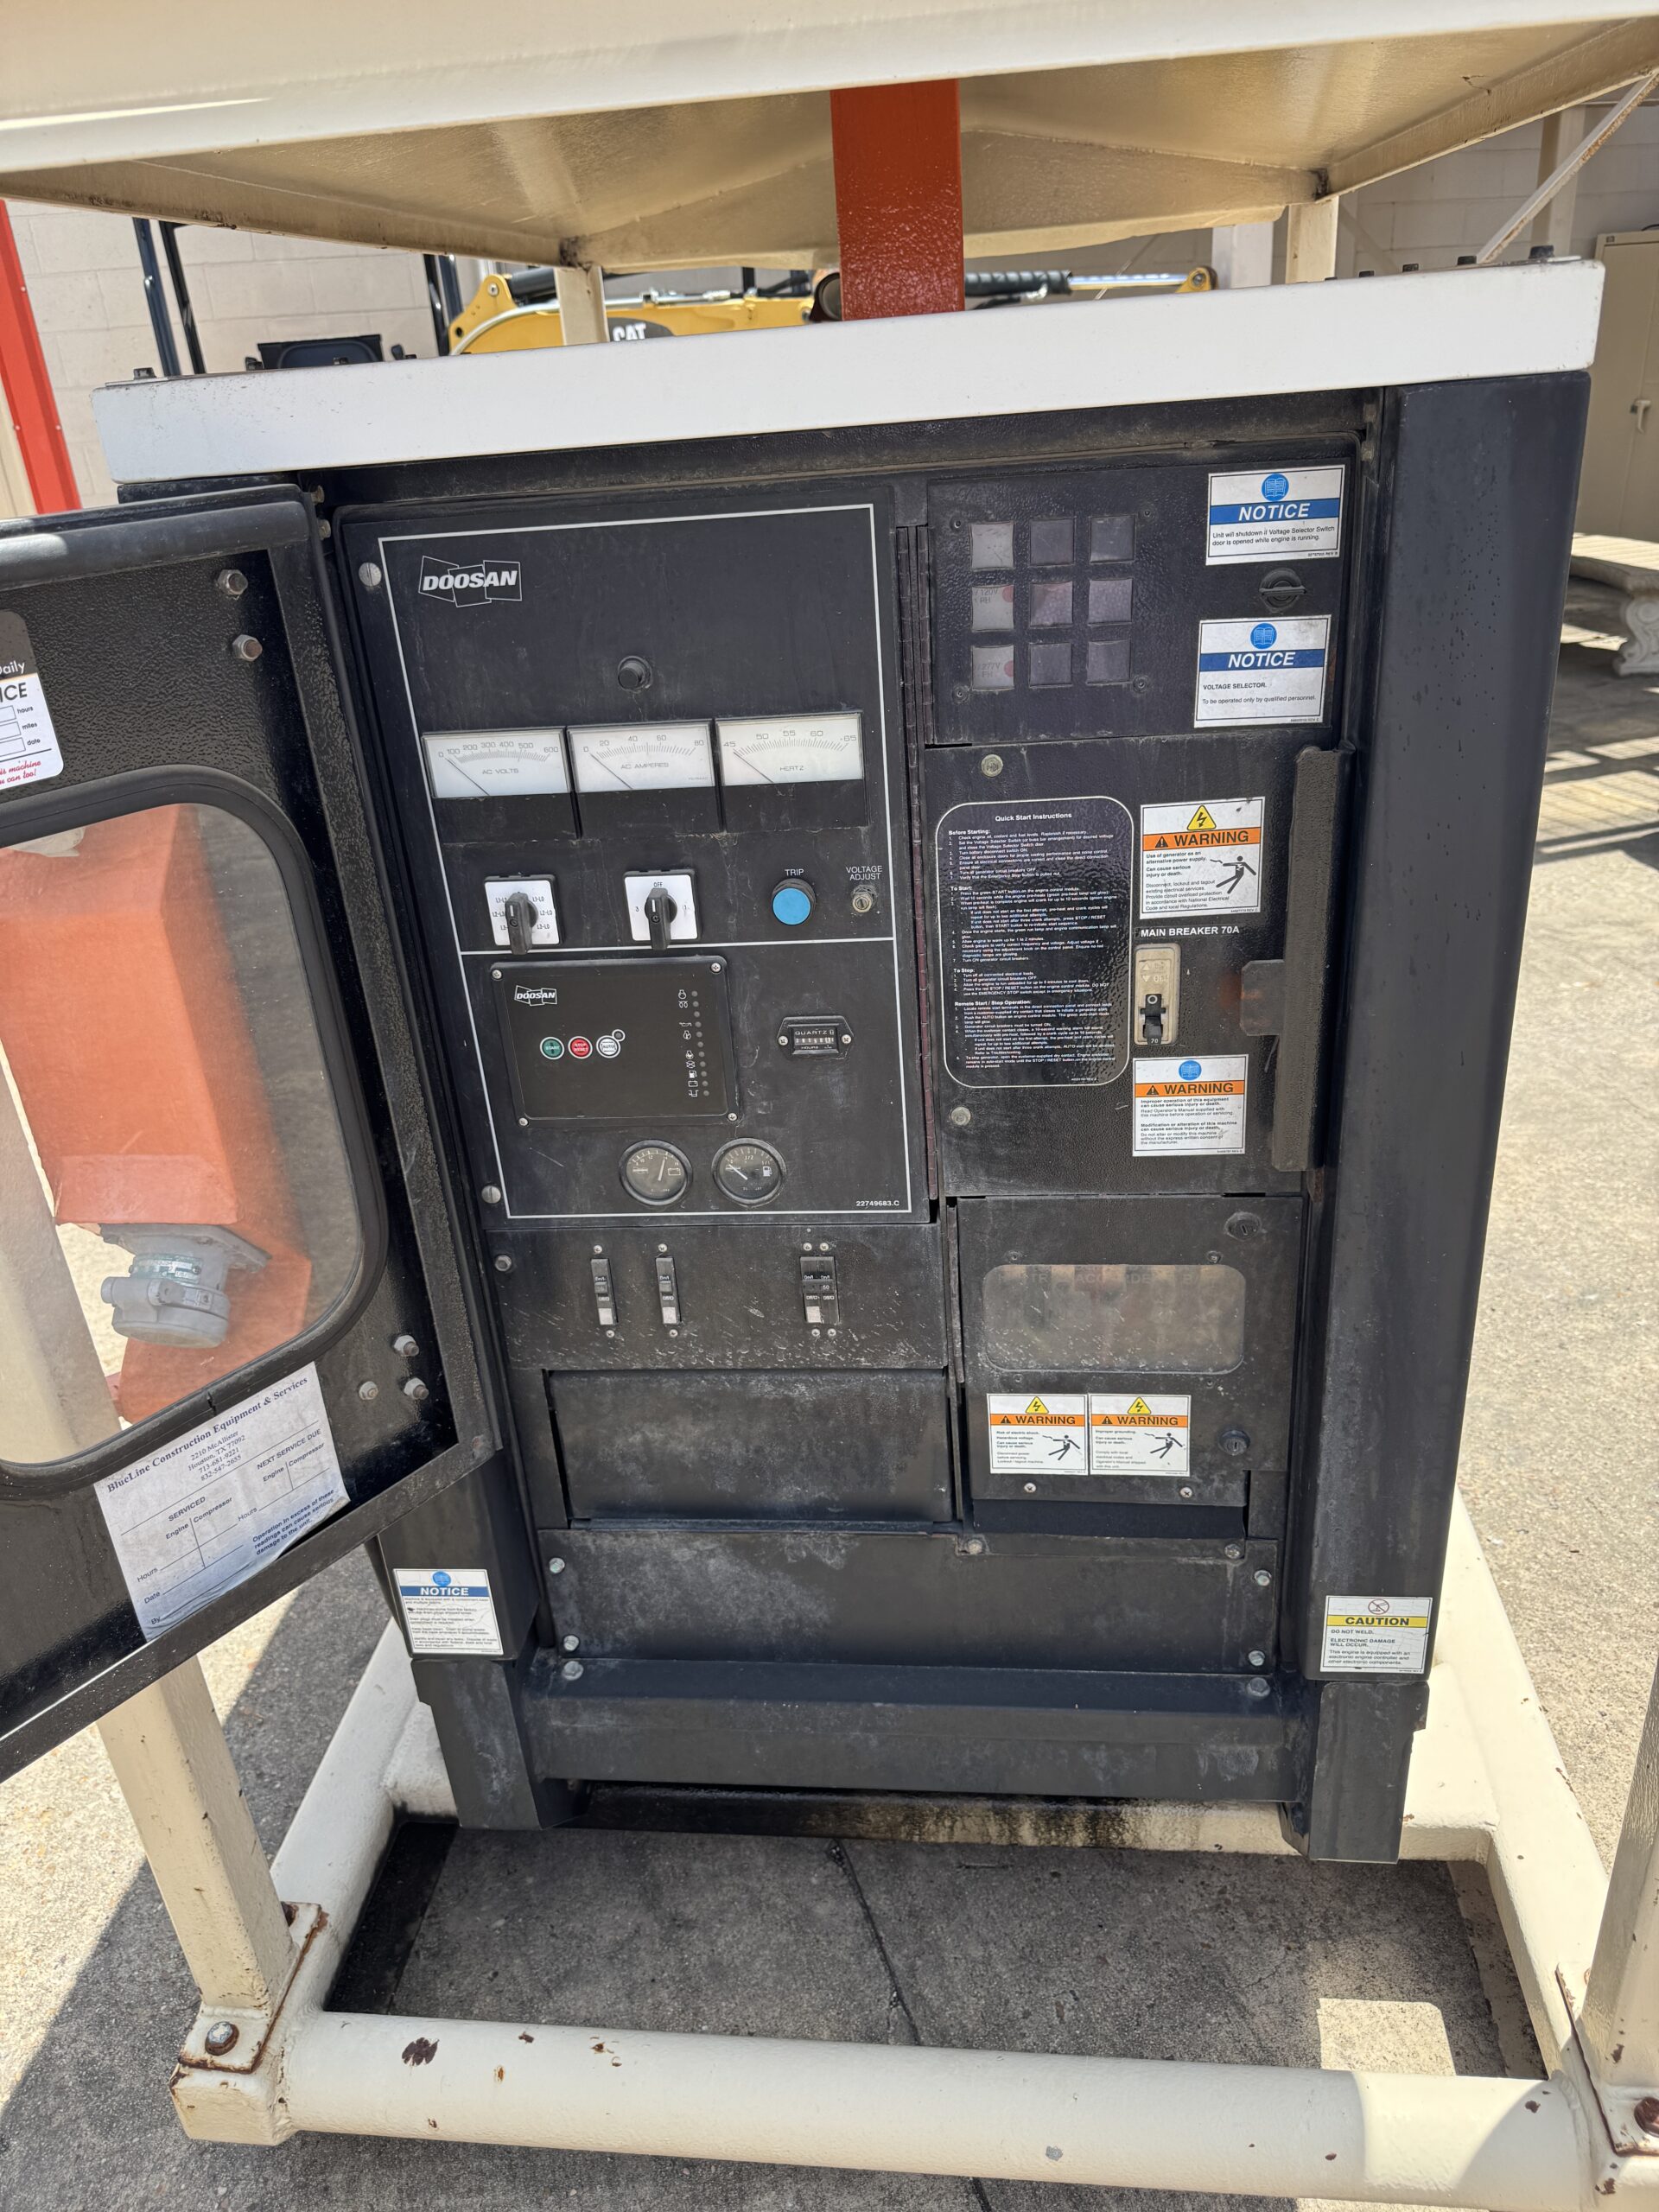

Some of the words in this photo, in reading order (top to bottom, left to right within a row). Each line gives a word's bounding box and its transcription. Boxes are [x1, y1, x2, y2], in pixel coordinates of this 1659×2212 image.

[613, 322, 646, 342] CAT
[1238, 503, 1310, 521] NOTICE
[423, 570, 518, 591] DOOSAN
[1228, 652, 1296, 668] NOTICE
[1174, 830, 1249, 847] WARNING
[846, 865, 883, 874] VOLTAGE
[1141, 928, 1166, 938] MAIN
[1168, 927, 1218, 936] BREAKER
[1221, 925, 1240, 934] 70A
[1164, 1083, 1235, 1095] WARNING
[1015, 1415, 1076, 1425] WARNING
[1117, 1416, 1179, 1426] WARNING
[107, 1465, 150, 1493] BlueLine
[152, 1431, 212, 1466] Construction
[213, 1402, 262, 1434] Equipment
[264, 1396, 271, 1406] &
[273, 1376, 308, 1400] Services
[188, 1453, 215, 1471] Houston,
[216, 1446, 226, 1455] TX
[227, 1434, 245, 1449] 77092
[191, 1449, 207, 1460] 2210
[207, 1431, 238, 1452] McAllister
[257, 1455, 276, 1470] NEXT
[276, 1437, 307, 1459] SERVICE
[307, 1428, 321, 1440] DUE
[263, 1467, 284, 1482] Engine
[289, 1442, 325, 1466] Compressor
[168, 1496, 206, 1522] SERVICED
[238, 1507, 257, 1522] Hours
[252, 1522, 283, 1542] Operation
[290, 1504, 310, 1519] excess
[318, 1490, 334, 1502] these
[165, 1523, 189, 1540] Engine
[193, 1497, 232, 1522] Compressor
[255, 1531, 281, 1549] readings
[282, 1523, 293, 1532] can
[294, 1512, 311, 1525] cause
[312, 1498, 334, 1512] serious
[257, 1539, 281, 1555] damage
[289, 1527, 298, 1535] the
[137, 1567, 158, 1582] Hours
[143, 1591, 162, 1605] Date
[420, 1587, 469, 1596] NOTICE
[150, 1616, 161, 1626] By
[1345, 1617, 1409, 1626] CAUTION
